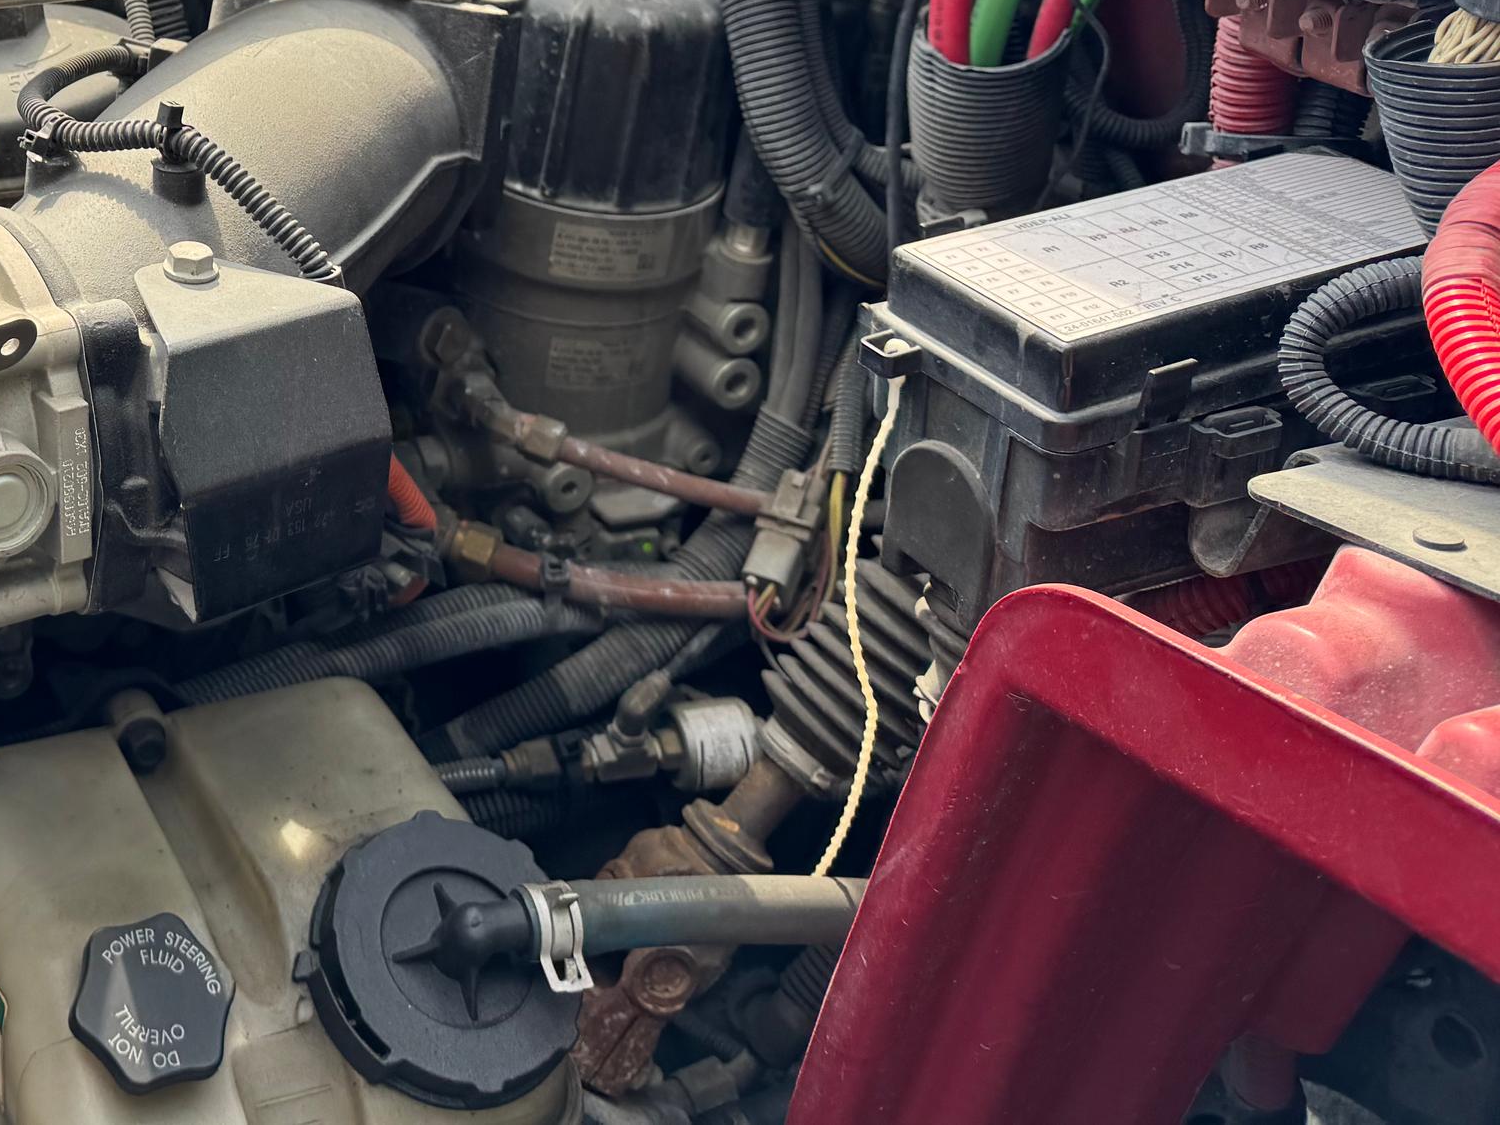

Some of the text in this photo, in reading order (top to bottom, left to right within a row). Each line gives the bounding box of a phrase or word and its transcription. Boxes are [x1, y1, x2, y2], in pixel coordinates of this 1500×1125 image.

[1043, 244, 1062, 255] R1
[1089, 233, 1108, 243] R3
[1120, 225, 1138, 235] R4
[1145, 250, 1172, 261] F13
[1217, 250, 1238, 260] R7
[1249, 241, 1270, 252] R8
[1169, 260, 1195, 272] F14
[1108, 278, 1131, 289] R2
[1192, 272, 1219, 284] F15
[1144, 298, 1166, 311] REV
[102, 927, 221, 996] POWER STEERING
[140, 948, 185, 973] FLUID
[114, 1004, 185, 1046] OVERFILL
[107, 1032, 181, 1068] DO NOT
